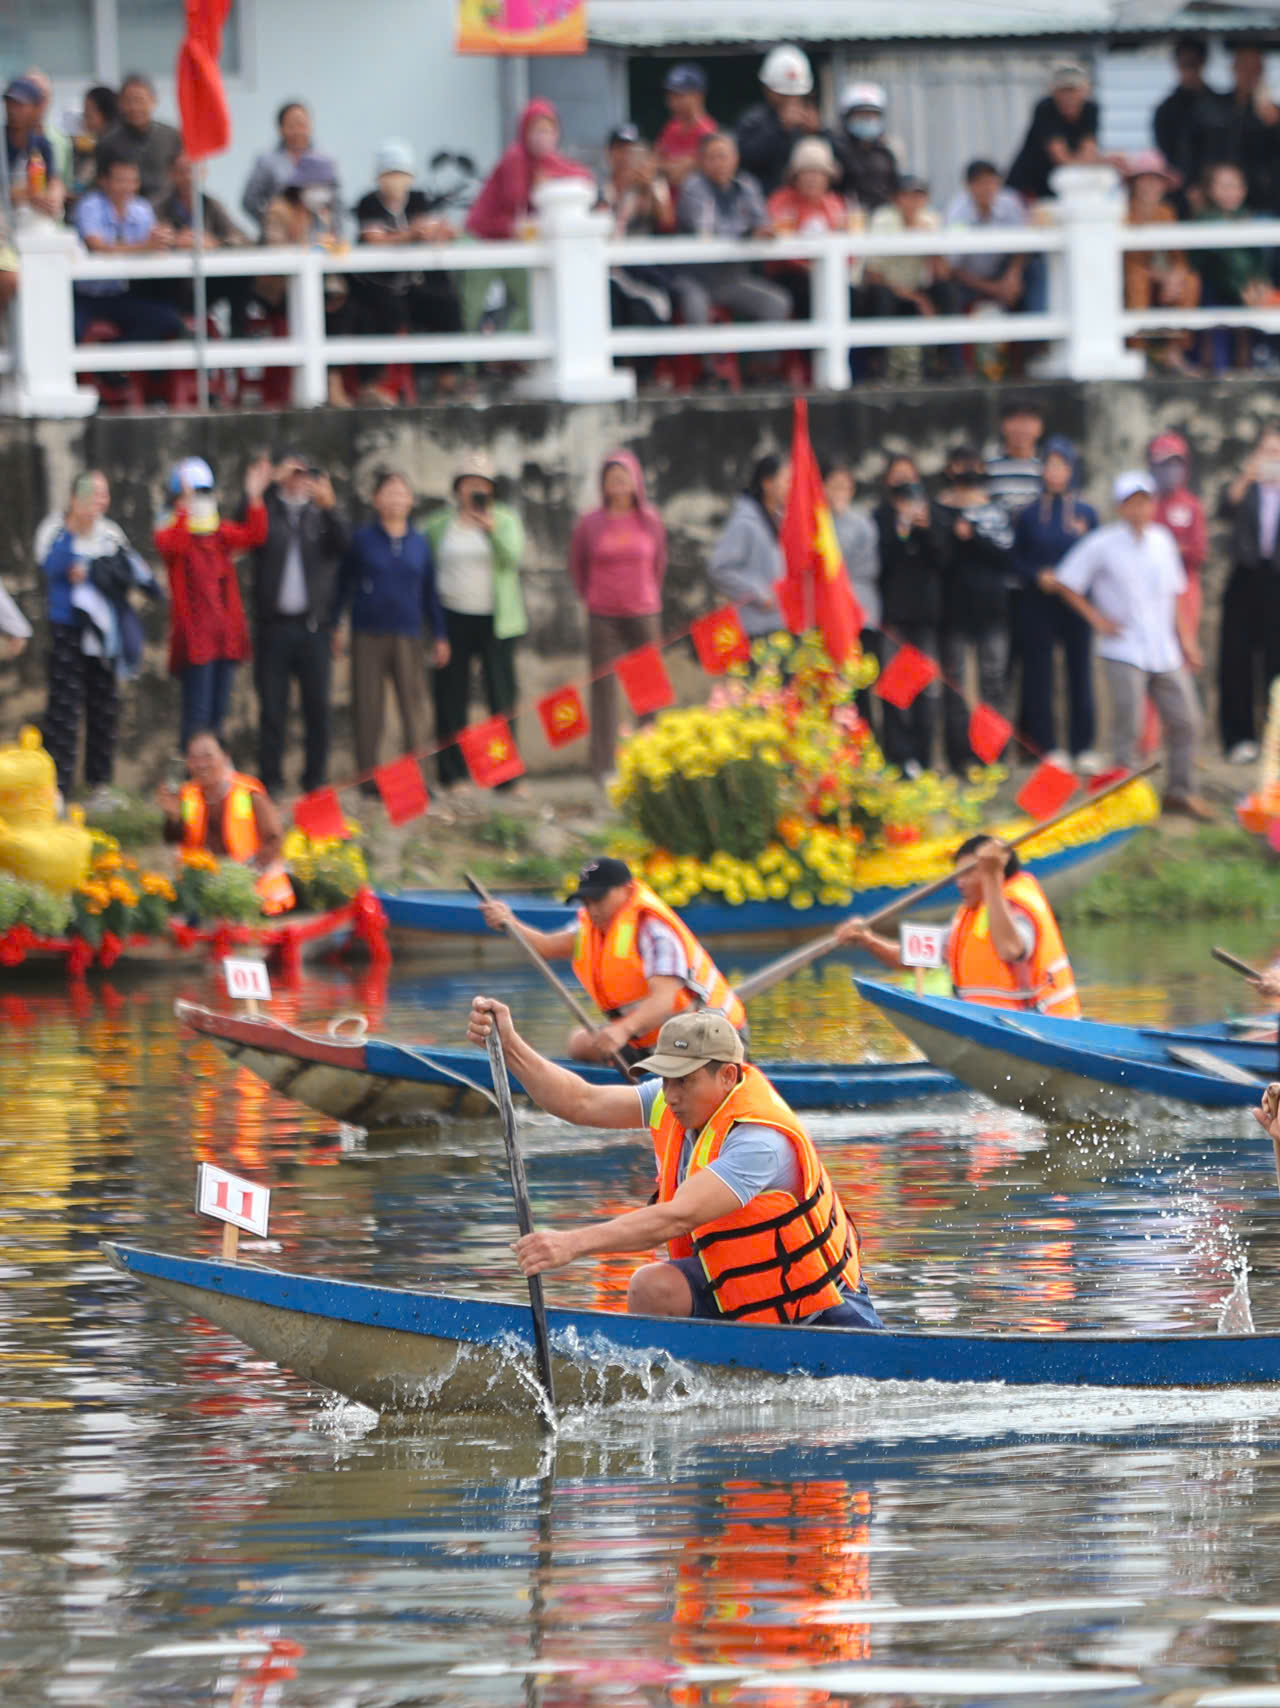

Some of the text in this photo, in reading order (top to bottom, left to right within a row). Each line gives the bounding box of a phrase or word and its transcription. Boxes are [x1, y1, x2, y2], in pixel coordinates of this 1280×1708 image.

[908, 935, 935, 959] 05
[233, 969, 260, 991] 01
[210, 1180, 257, 1223] 11
